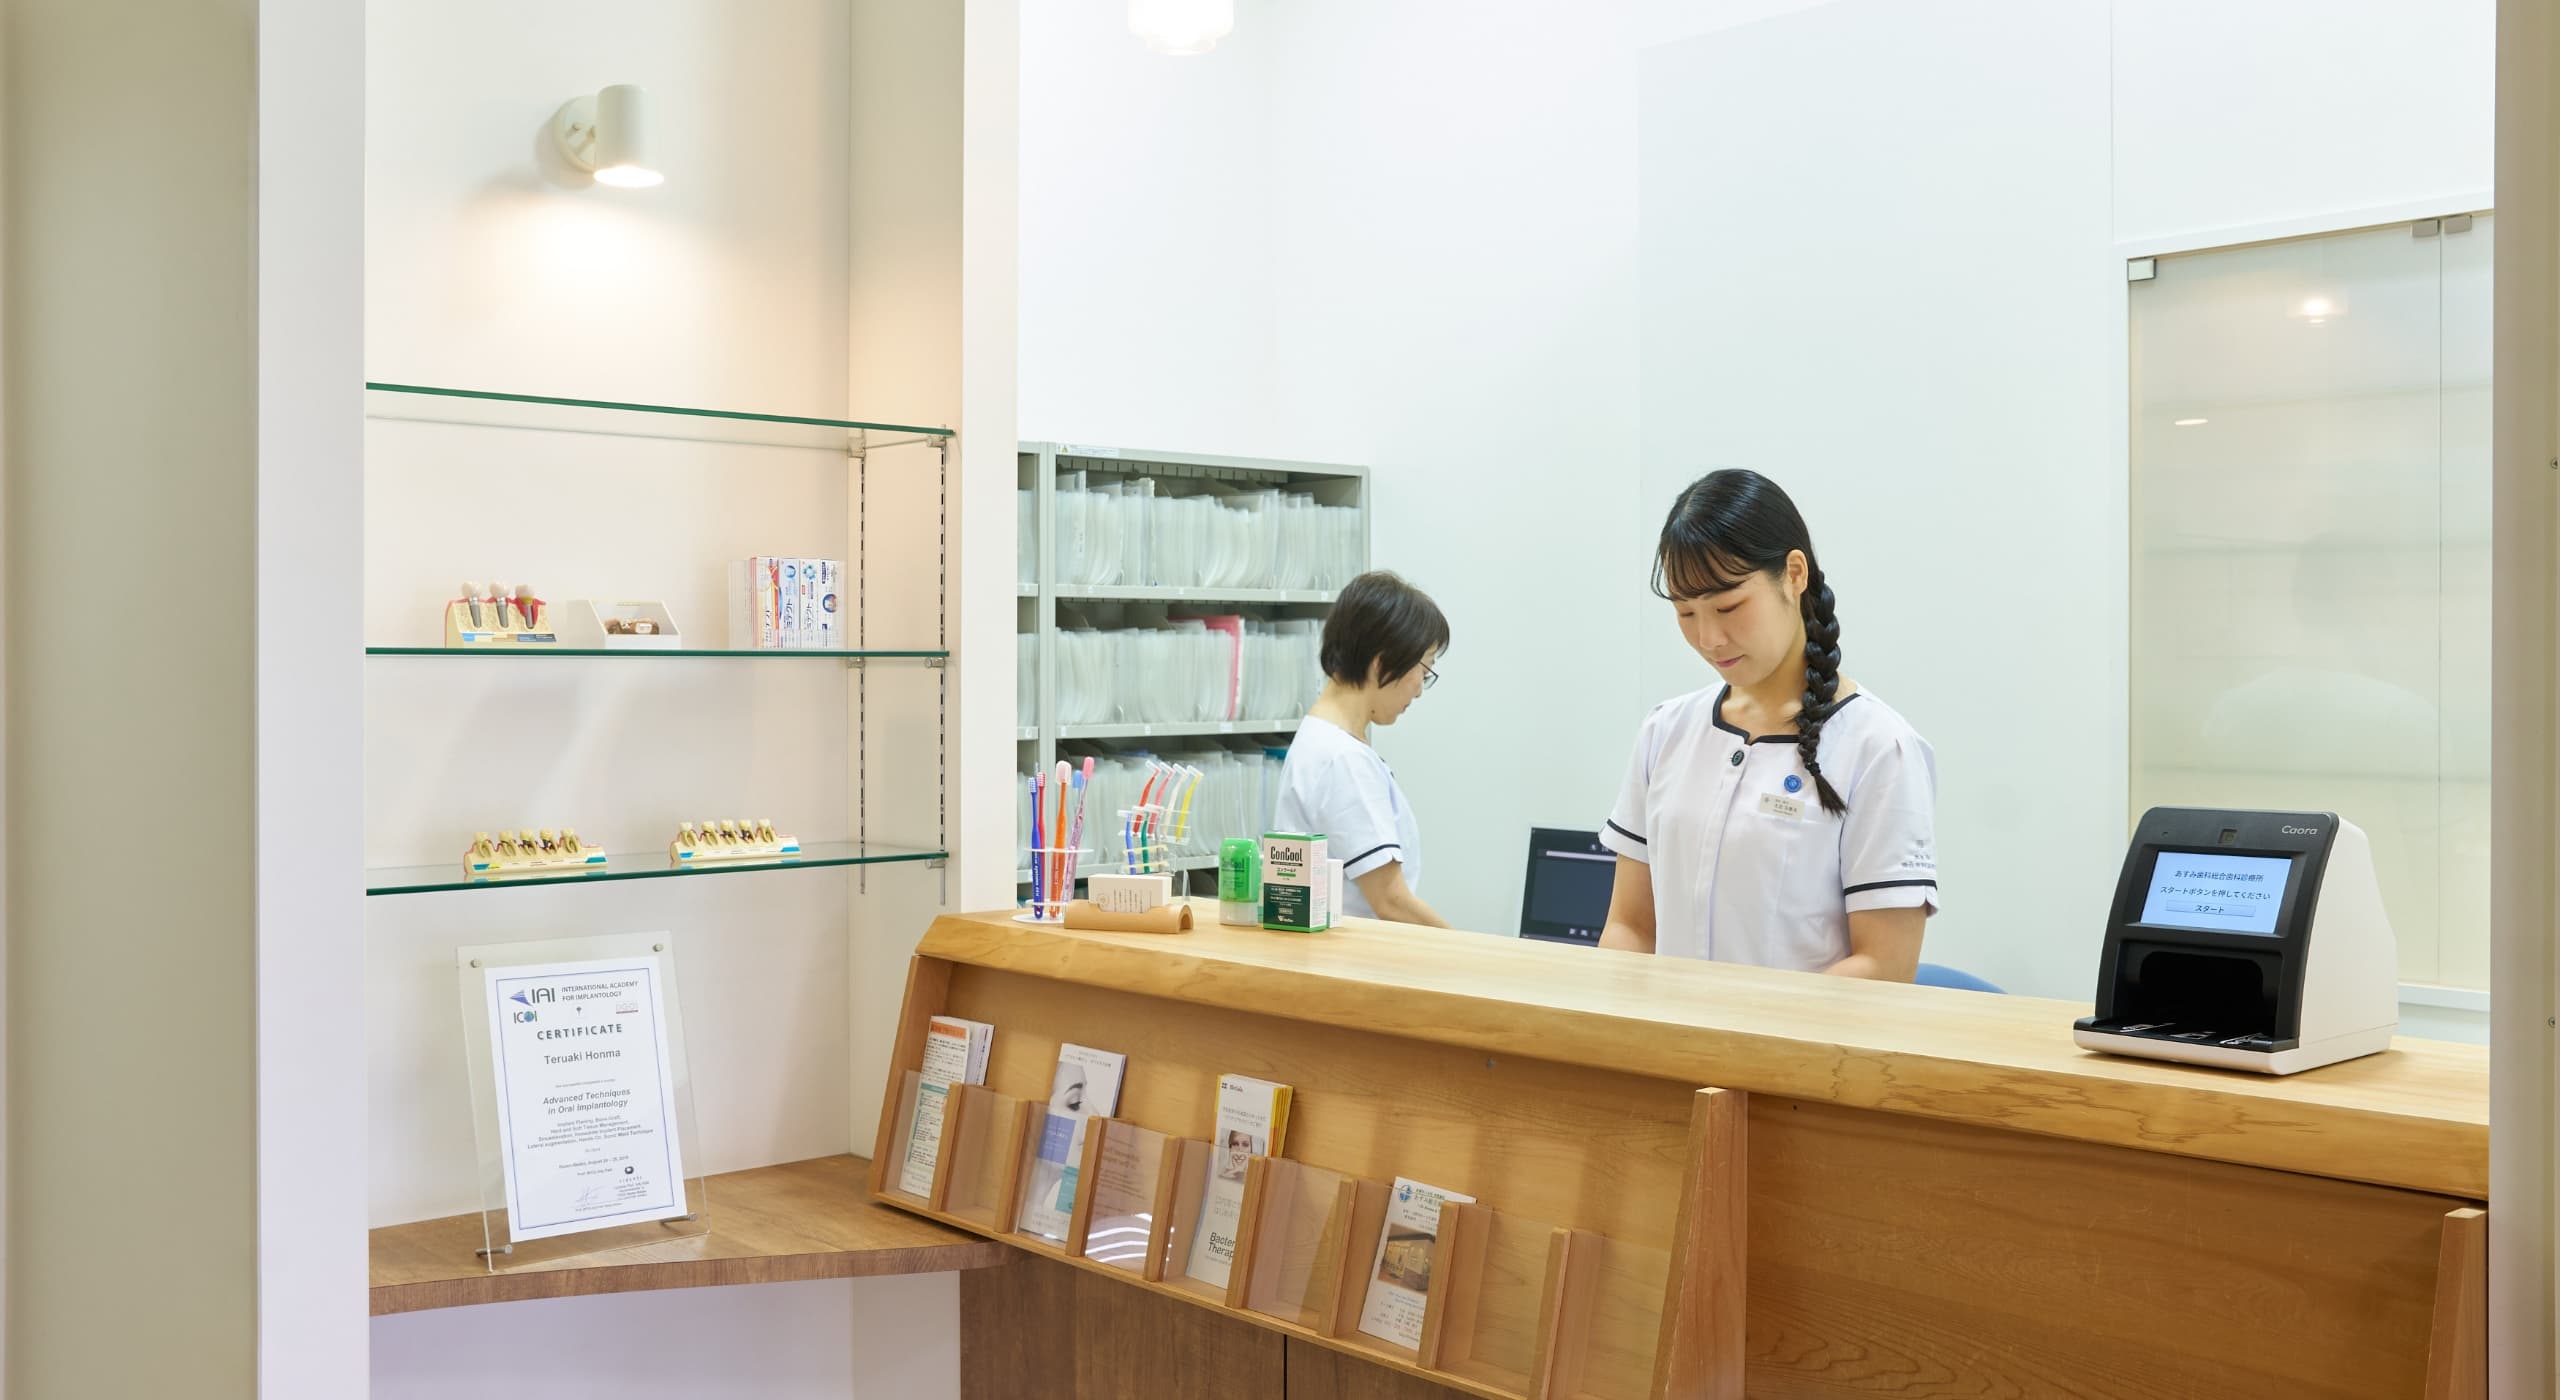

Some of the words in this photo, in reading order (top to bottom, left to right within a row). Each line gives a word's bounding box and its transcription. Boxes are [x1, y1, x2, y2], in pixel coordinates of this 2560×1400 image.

[2281, 825, 2318, 835] Caora
[1270, 846, 1303, 862] ConCool
[2160, 886, 2271, 900] スタートボタンを押してください
[2194, 904, 2225, 914] スタート
[531, 987, 556, 1004] IAI
[561, 983, 609, 993] INTERNATIONAL
[575, 991, 622, 1000] IMPLANTOLOGY
[537, 1023, 623, 1041] CERTIFICATE
[544, 1051, 583, 1065] Teruaki
[585, 1049, 621, 1060] Honma
[543, 1093, 583, 1105] Advanced
[586, 1088, 631, 1100] Techniques
[548, 1107, 556, 1115] in
[558, 1104, 575, 1114] Oral
[577, 1099, 629, 1112] Implantology
[1210, 1231, 1236, 1247] Bacter
[1208, 1241, 1235, 1261] Therap
